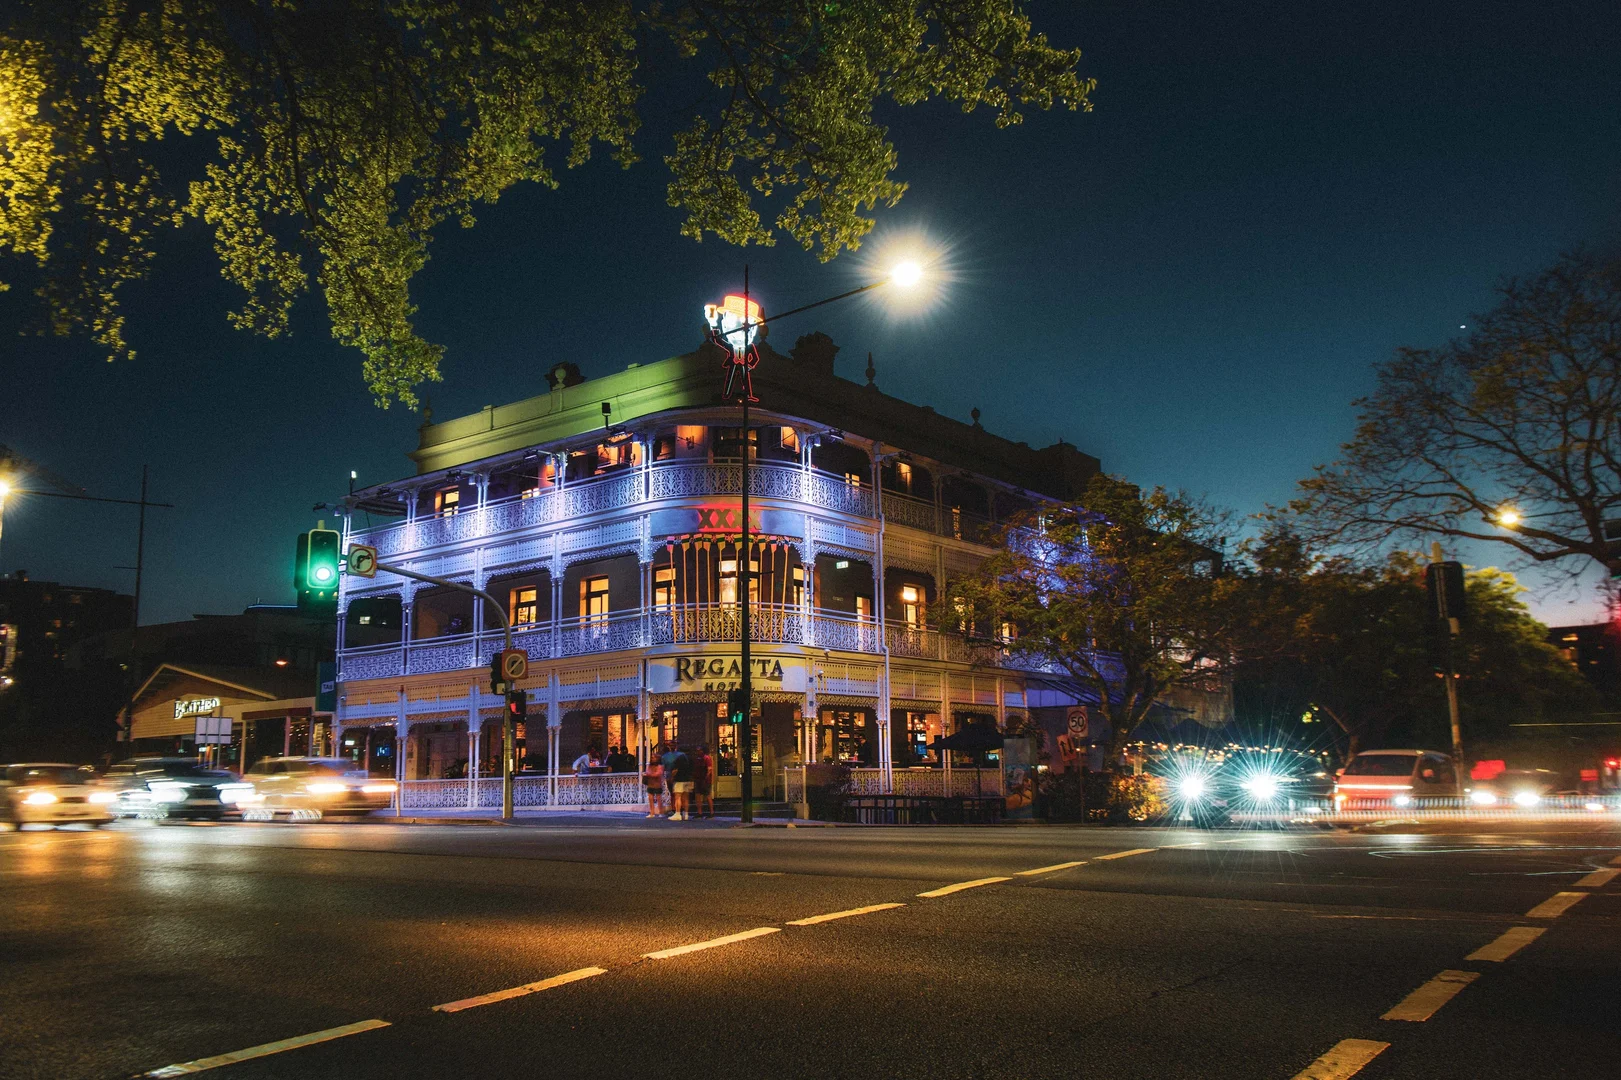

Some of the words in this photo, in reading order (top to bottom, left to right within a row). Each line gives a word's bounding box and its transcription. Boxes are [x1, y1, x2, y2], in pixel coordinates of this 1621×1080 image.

[697, 509, 762, 530] XXXX
[704, 681, 756, 692] HOT
[1071, 716, 1084, 727] 50
